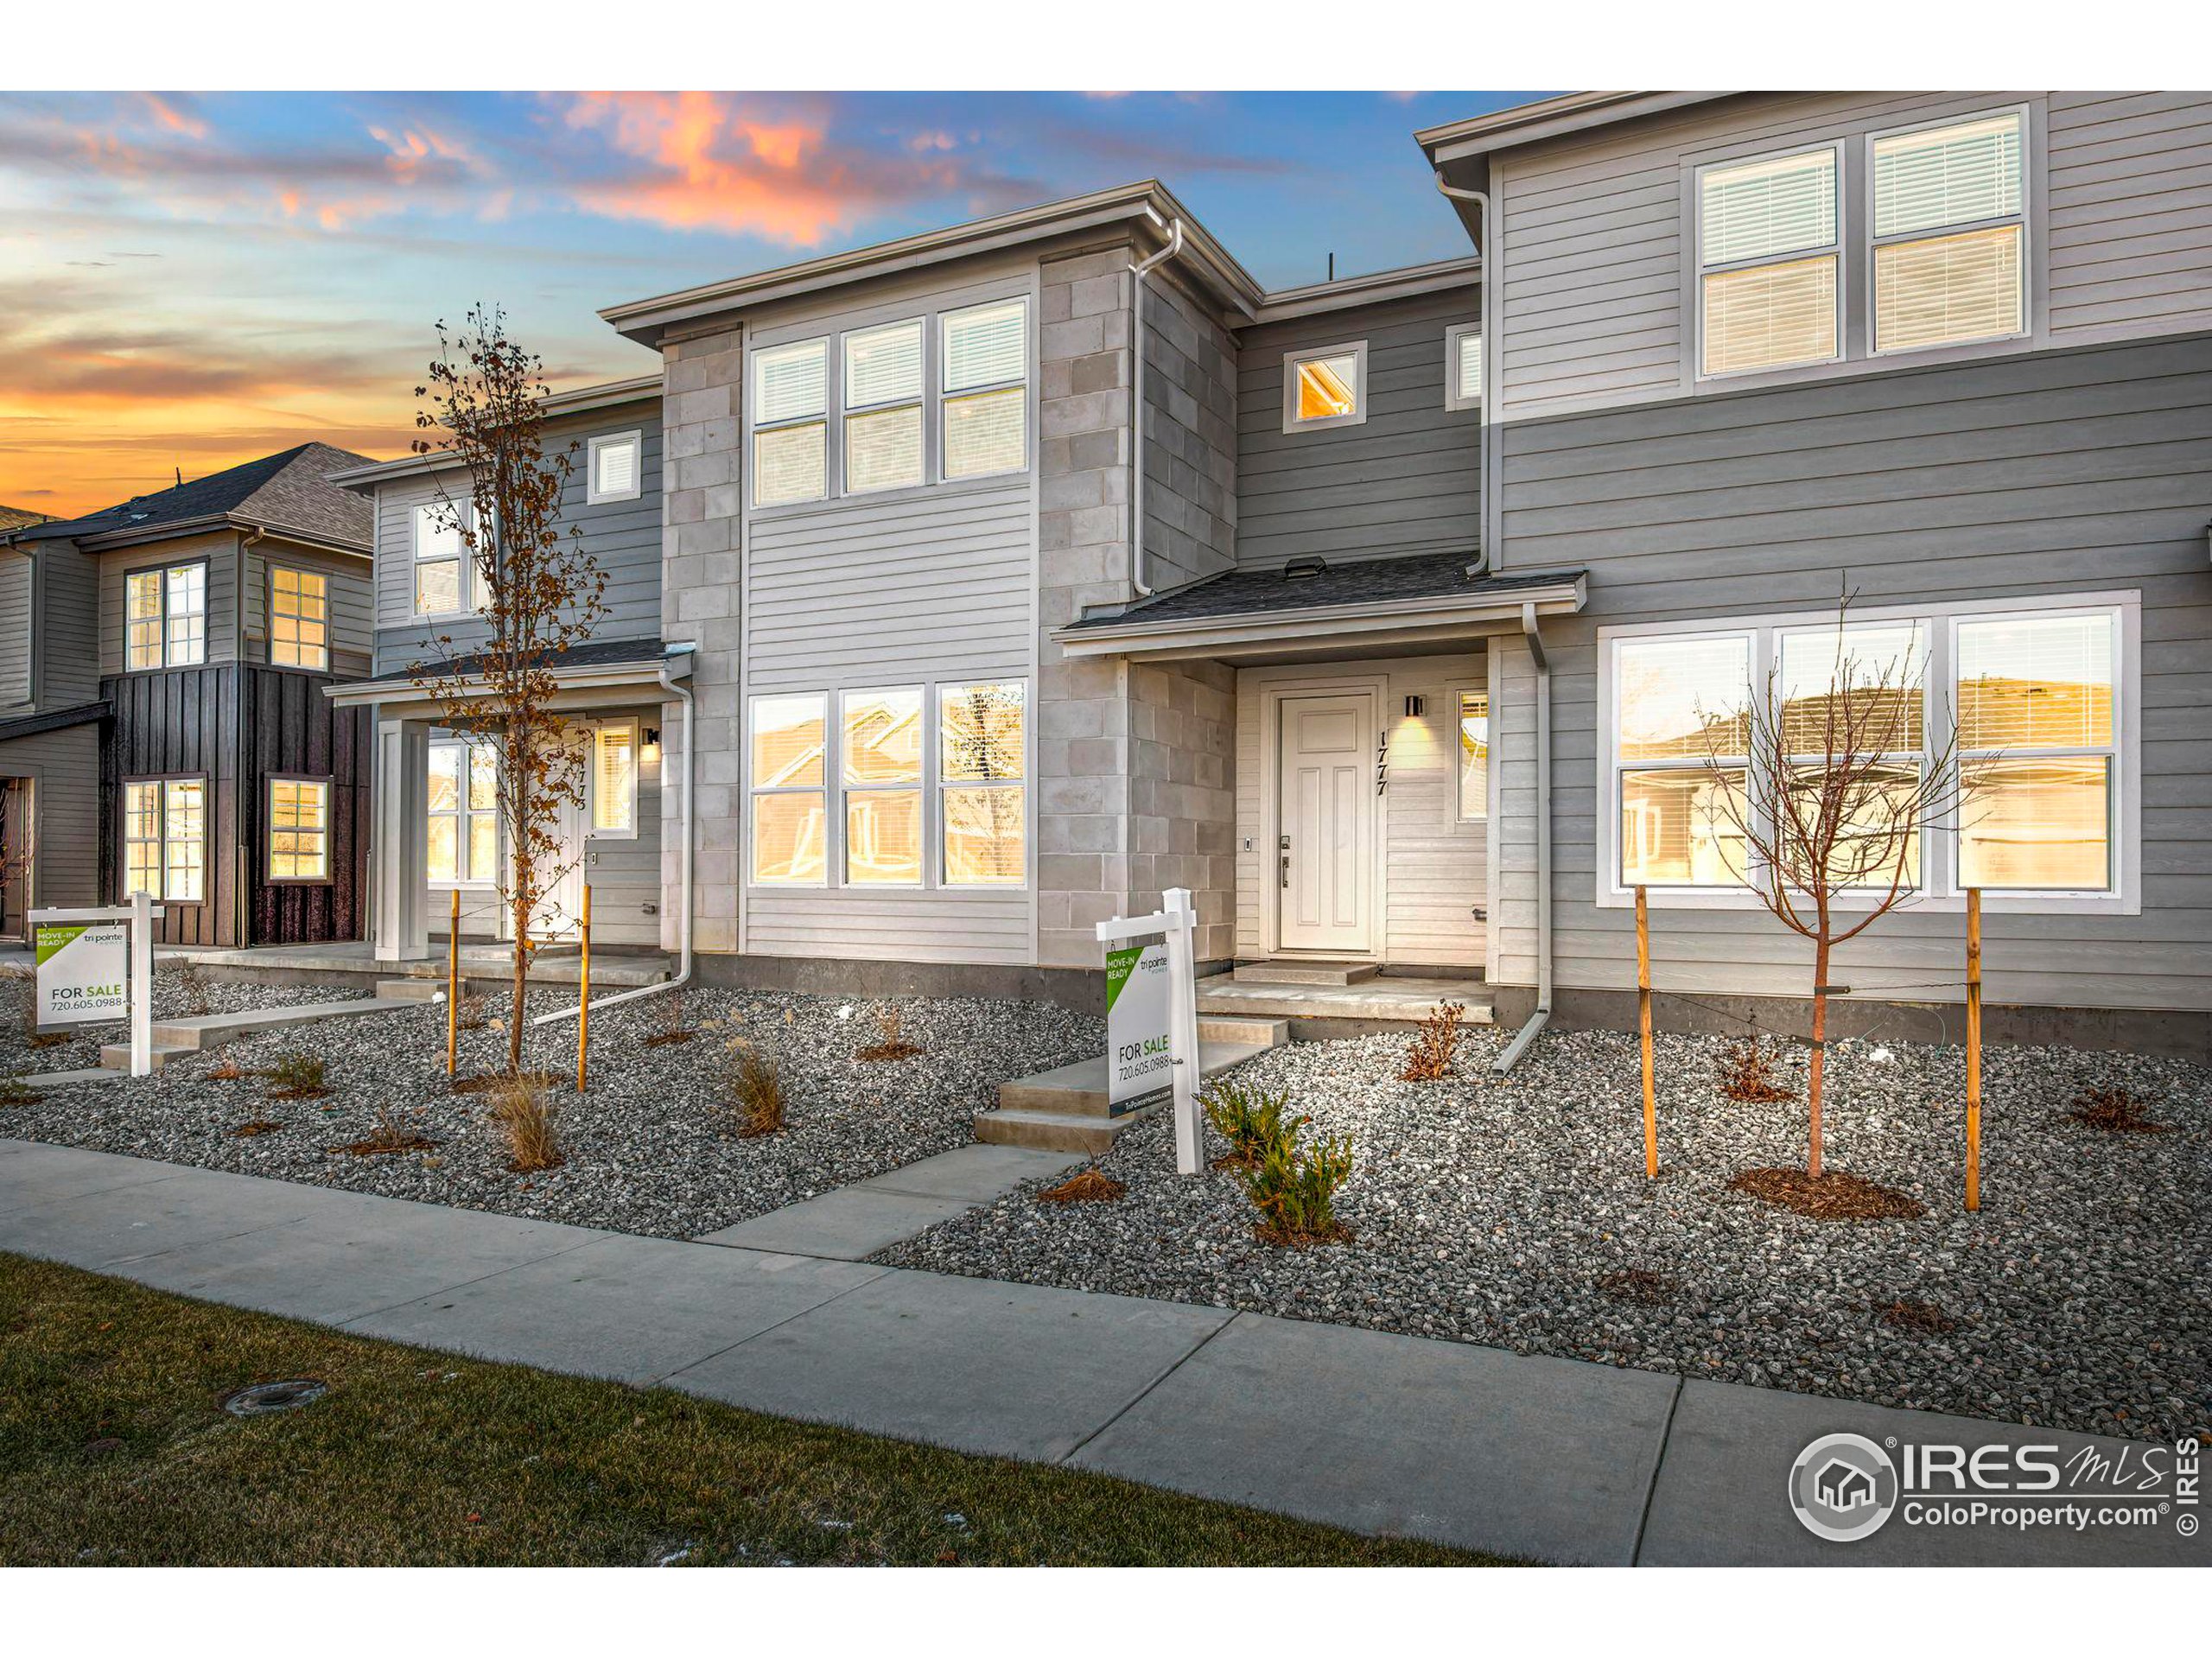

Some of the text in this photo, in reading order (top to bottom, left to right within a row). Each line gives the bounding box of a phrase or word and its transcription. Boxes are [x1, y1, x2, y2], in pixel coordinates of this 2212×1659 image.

[1377, 732, 1388, 796] 1777
[95, 933, 123, 943] pointe
[1108, 956, 1135, 969] MOVE-IN
[1148, 957, 1166, 971] pointe
[1108, 969, 1128, 980] READY
[52, 985, 122, 1000] FOR SALE
[51, 998, 122, 1011] 720.605.0988
[1120, 1034, 1168, 1063] FOR SALE
[1118, 1054, 1169, 1082] 720.605.0988
